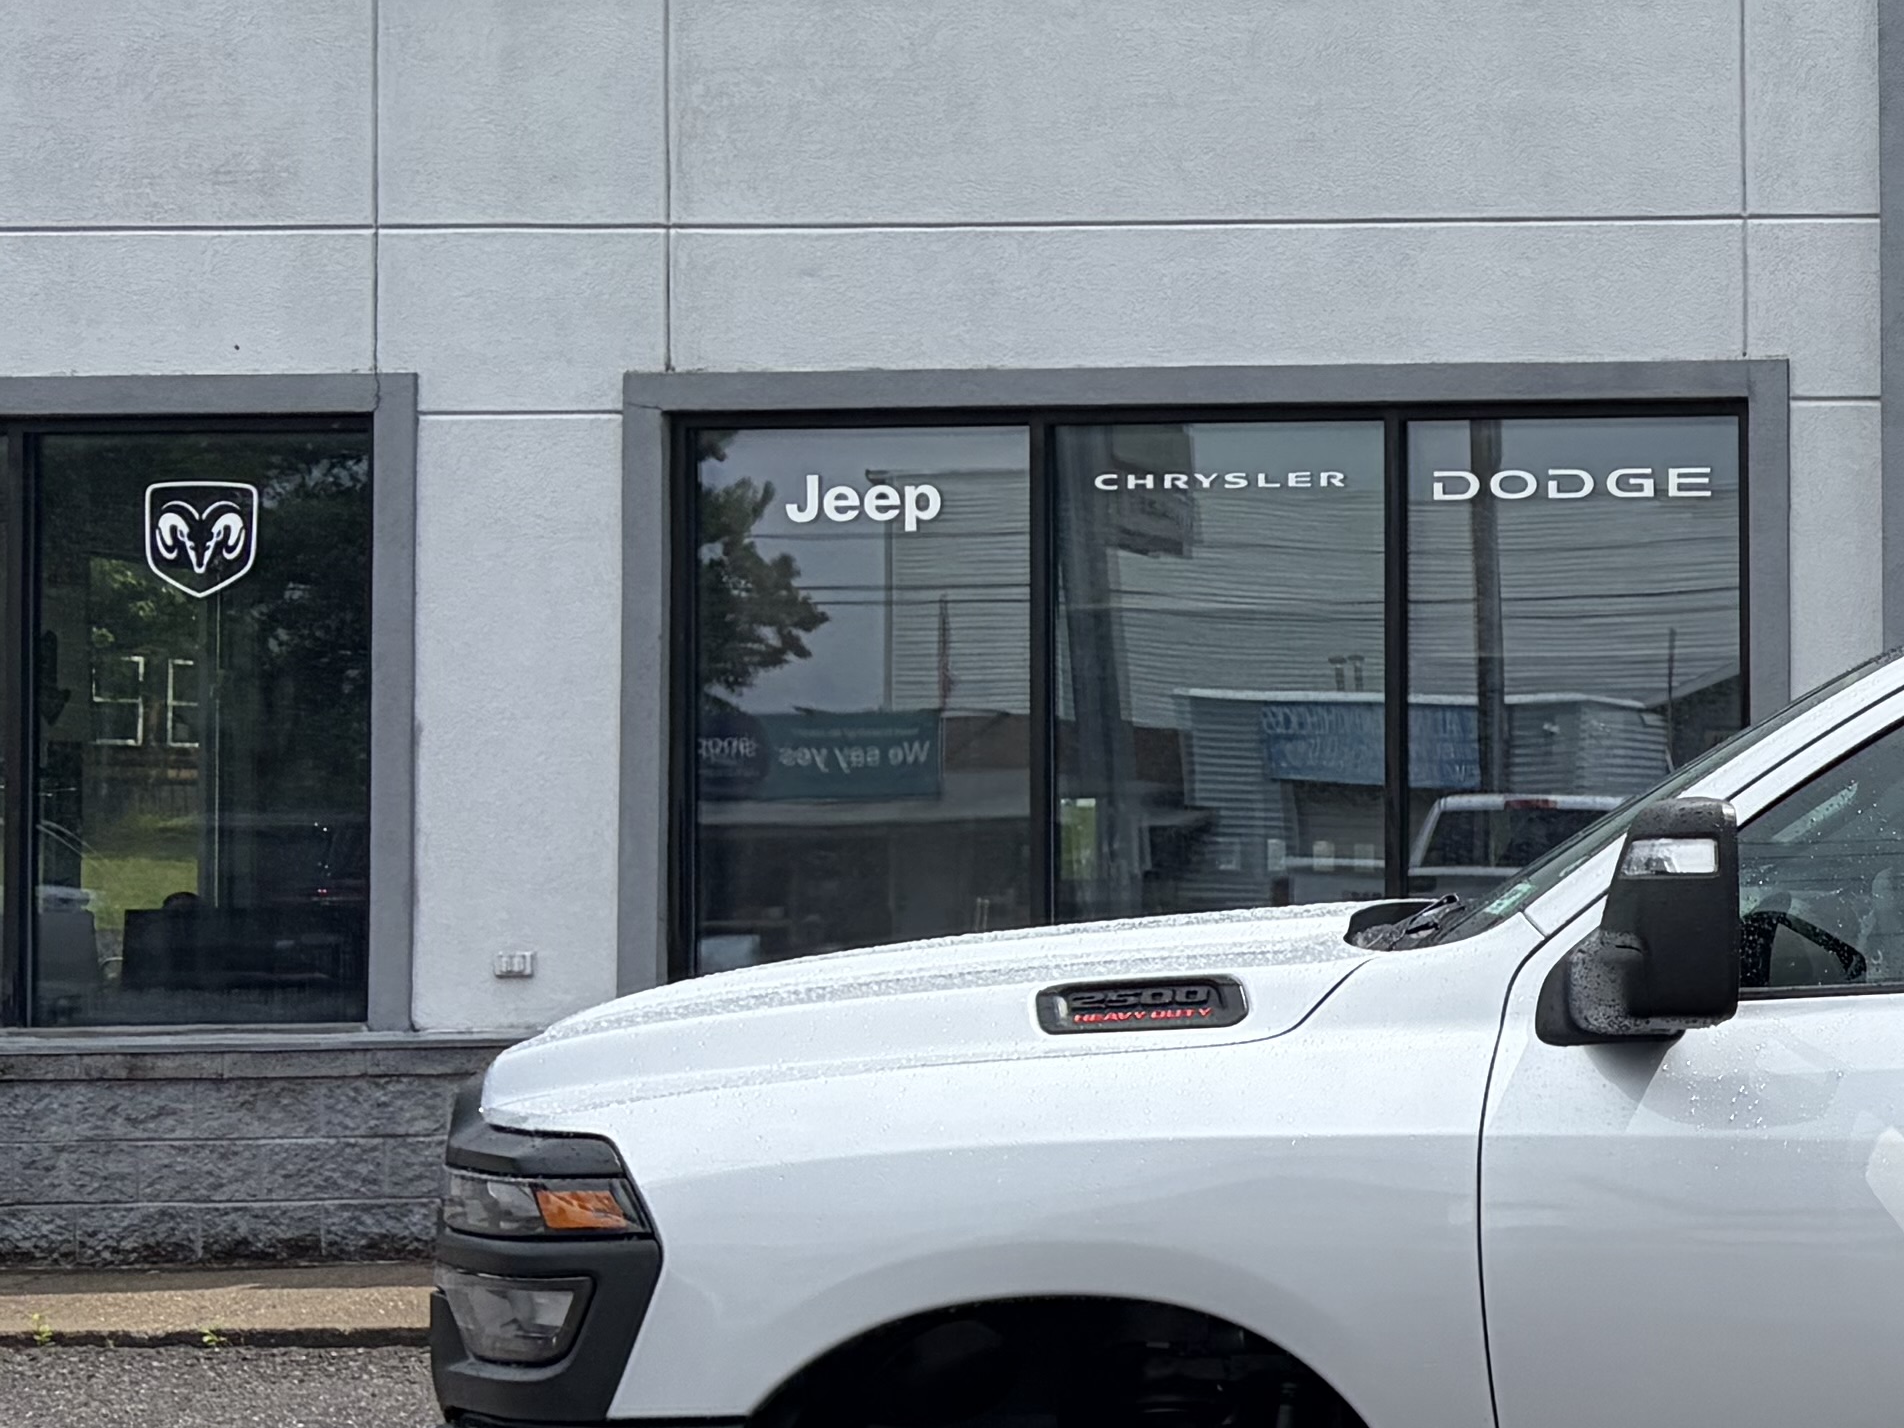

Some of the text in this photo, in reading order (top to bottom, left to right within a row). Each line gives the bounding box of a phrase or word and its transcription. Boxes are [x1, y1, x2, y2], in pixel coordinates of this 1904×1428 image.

[1093, 470, 1346, 491] CHRYSLER
[1432, 467, 1712, 501] DODGE
[785, 474, 942, 532] Jeep
[1070, 987, 1209, 1009] 2500
[1073, 1007, 1212, 1022] HEAVY DUTY
